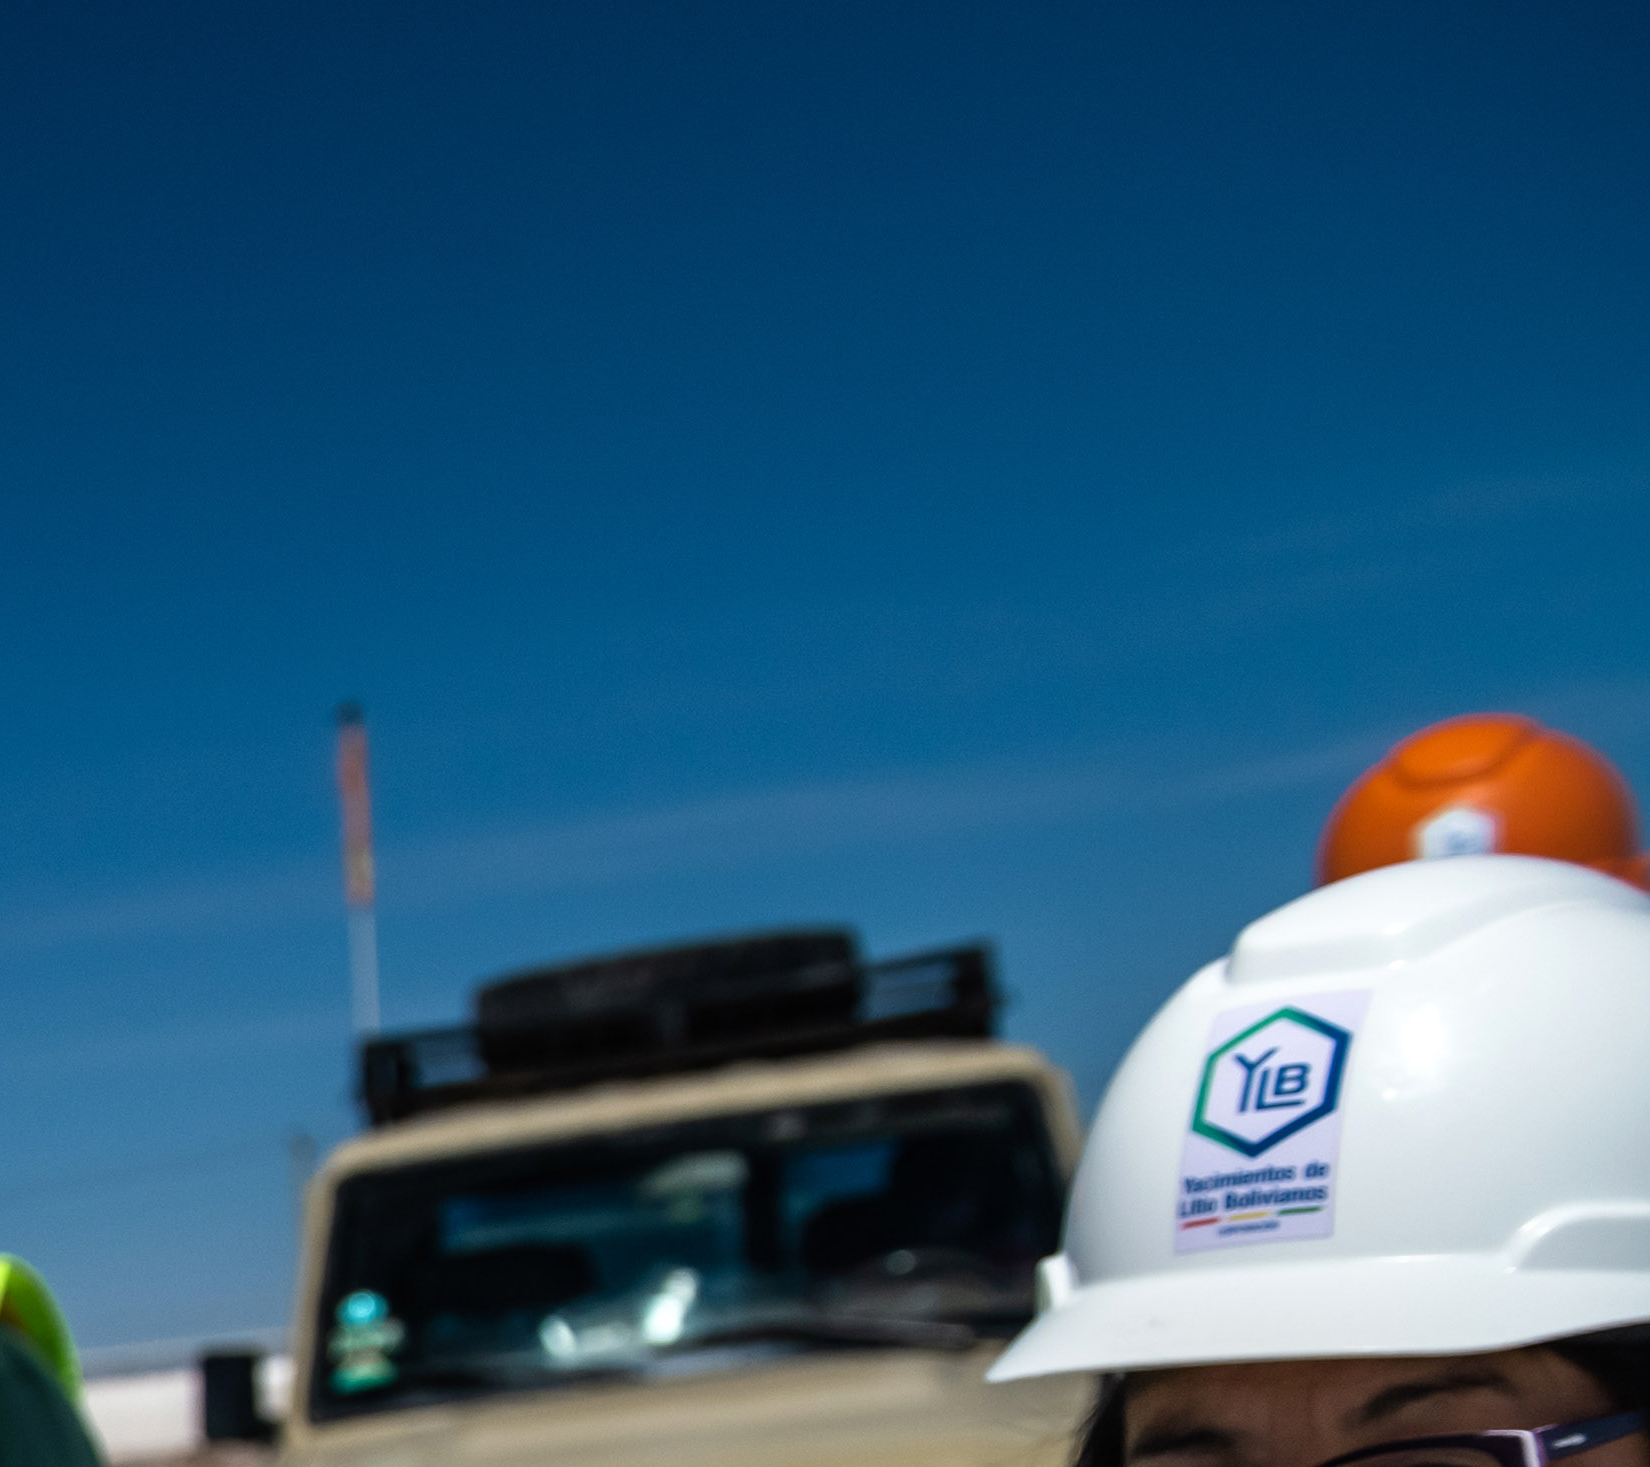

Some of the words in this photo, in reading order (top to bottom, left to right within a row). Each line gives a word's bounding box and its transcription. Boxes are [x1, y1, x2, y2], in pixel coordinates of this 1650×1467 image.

[1234, 1047, 1310, 1113] YLB
[1185, 1167, 1295, 1193] Yacimientos
[1305, 1161, 1328, 1178] de
[1225, 1187, 1327, 1209] Bolivianos
